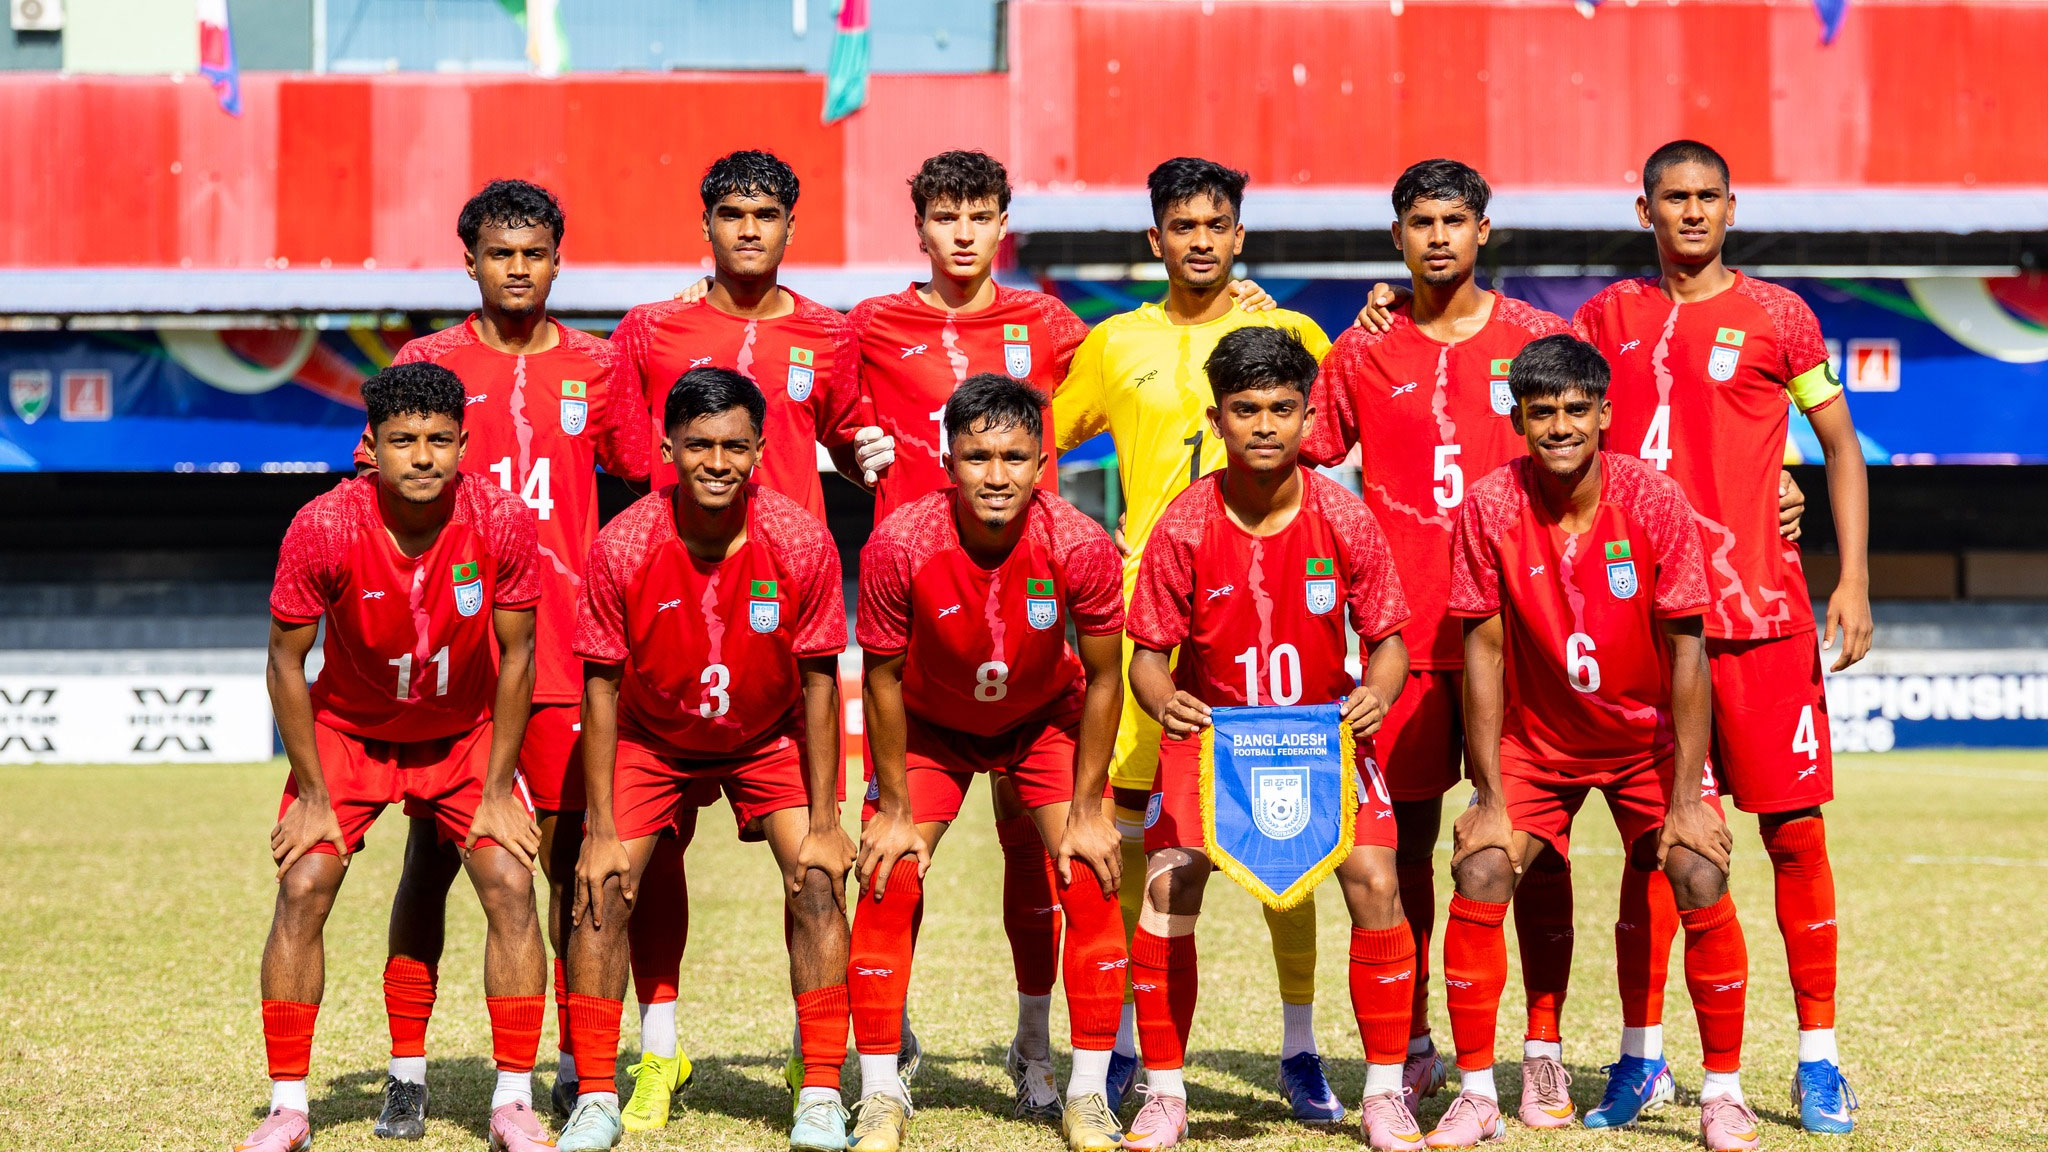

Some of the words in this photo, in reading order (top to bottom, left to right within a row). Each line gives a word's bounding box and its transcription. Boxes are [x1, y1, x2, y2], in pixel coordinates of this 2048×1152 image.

[1640, 404, 1673, 471] 4
[490, 457, 554, 520] 14
[1434, 444, 1463, 508] 5
[389, 646, 449, 700] 11
[974, 661, 1009, 702] 8
[1235, 644, 1303, 707] 10
[1566, 632, 1601, 693] 6
[700, 664, 730, 718] 3
[1233, 733, 1327, 748] BANGLADESH
[1234, 748, 1276, 756] FOOTBALL
[1277, 747, 1327, 756] FEDERATION
[1792, 705, 1819, 760] 4
